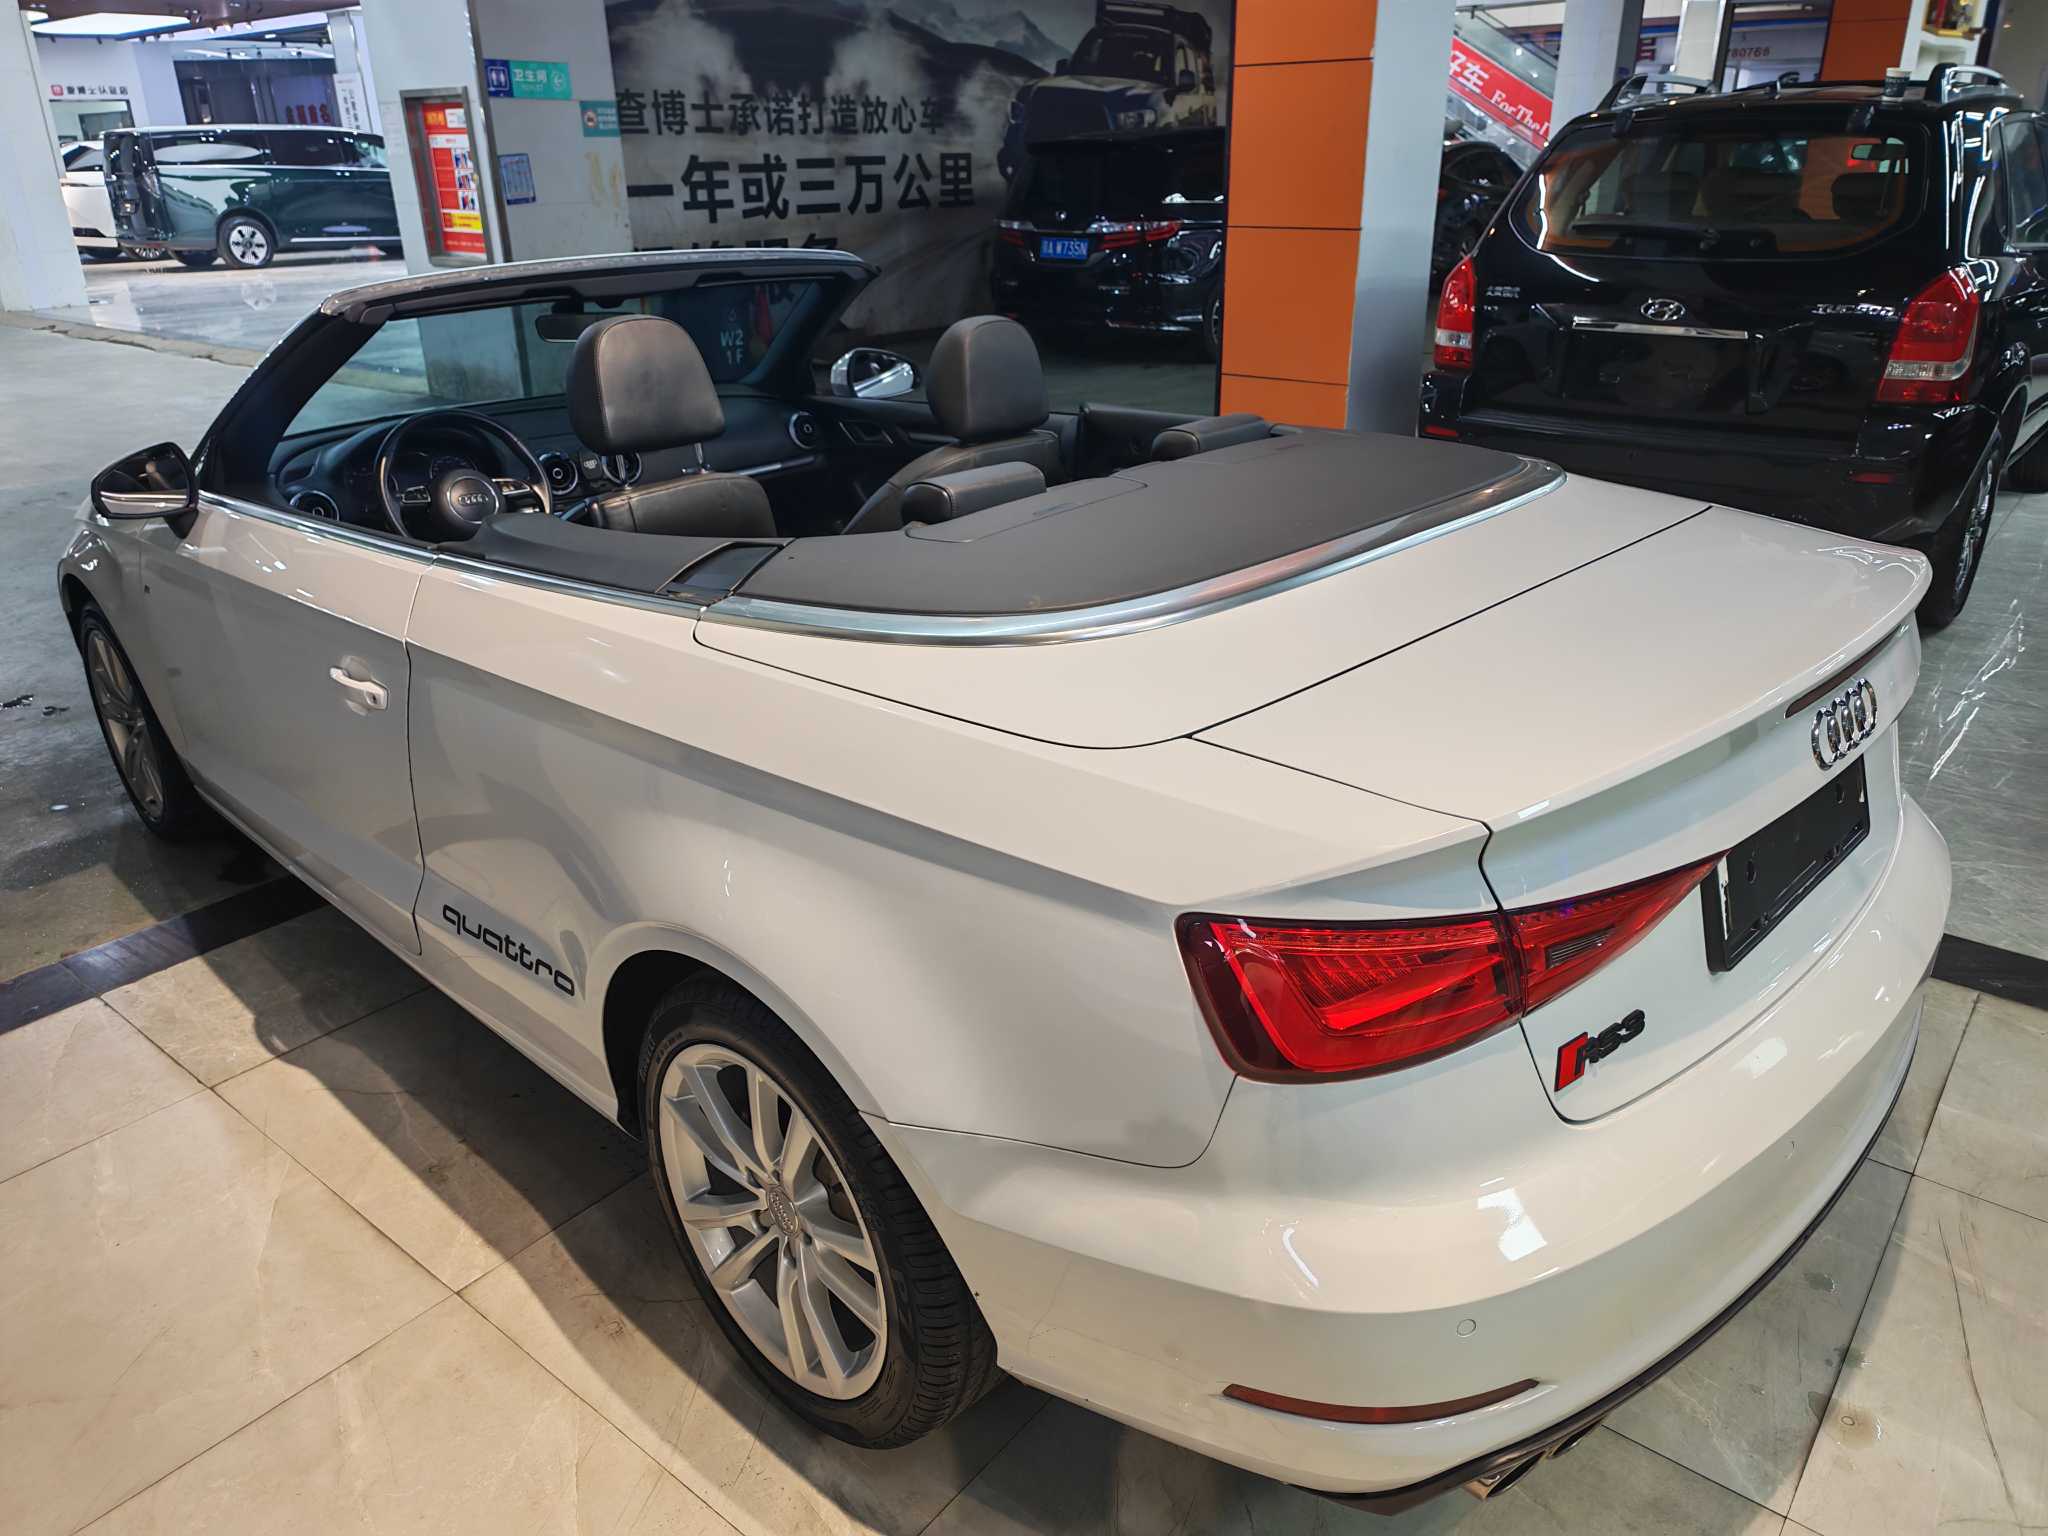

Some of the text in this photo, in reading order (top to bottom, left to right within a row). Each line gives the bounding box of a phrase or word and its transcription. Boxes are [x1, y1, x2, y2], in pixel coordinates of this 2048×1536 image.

[616, 88, 946, 137] 查博士承诺打造放心车
[626, 152, 974, 224] 一年或三万公里
[442, 904, 575, 997] quattro
